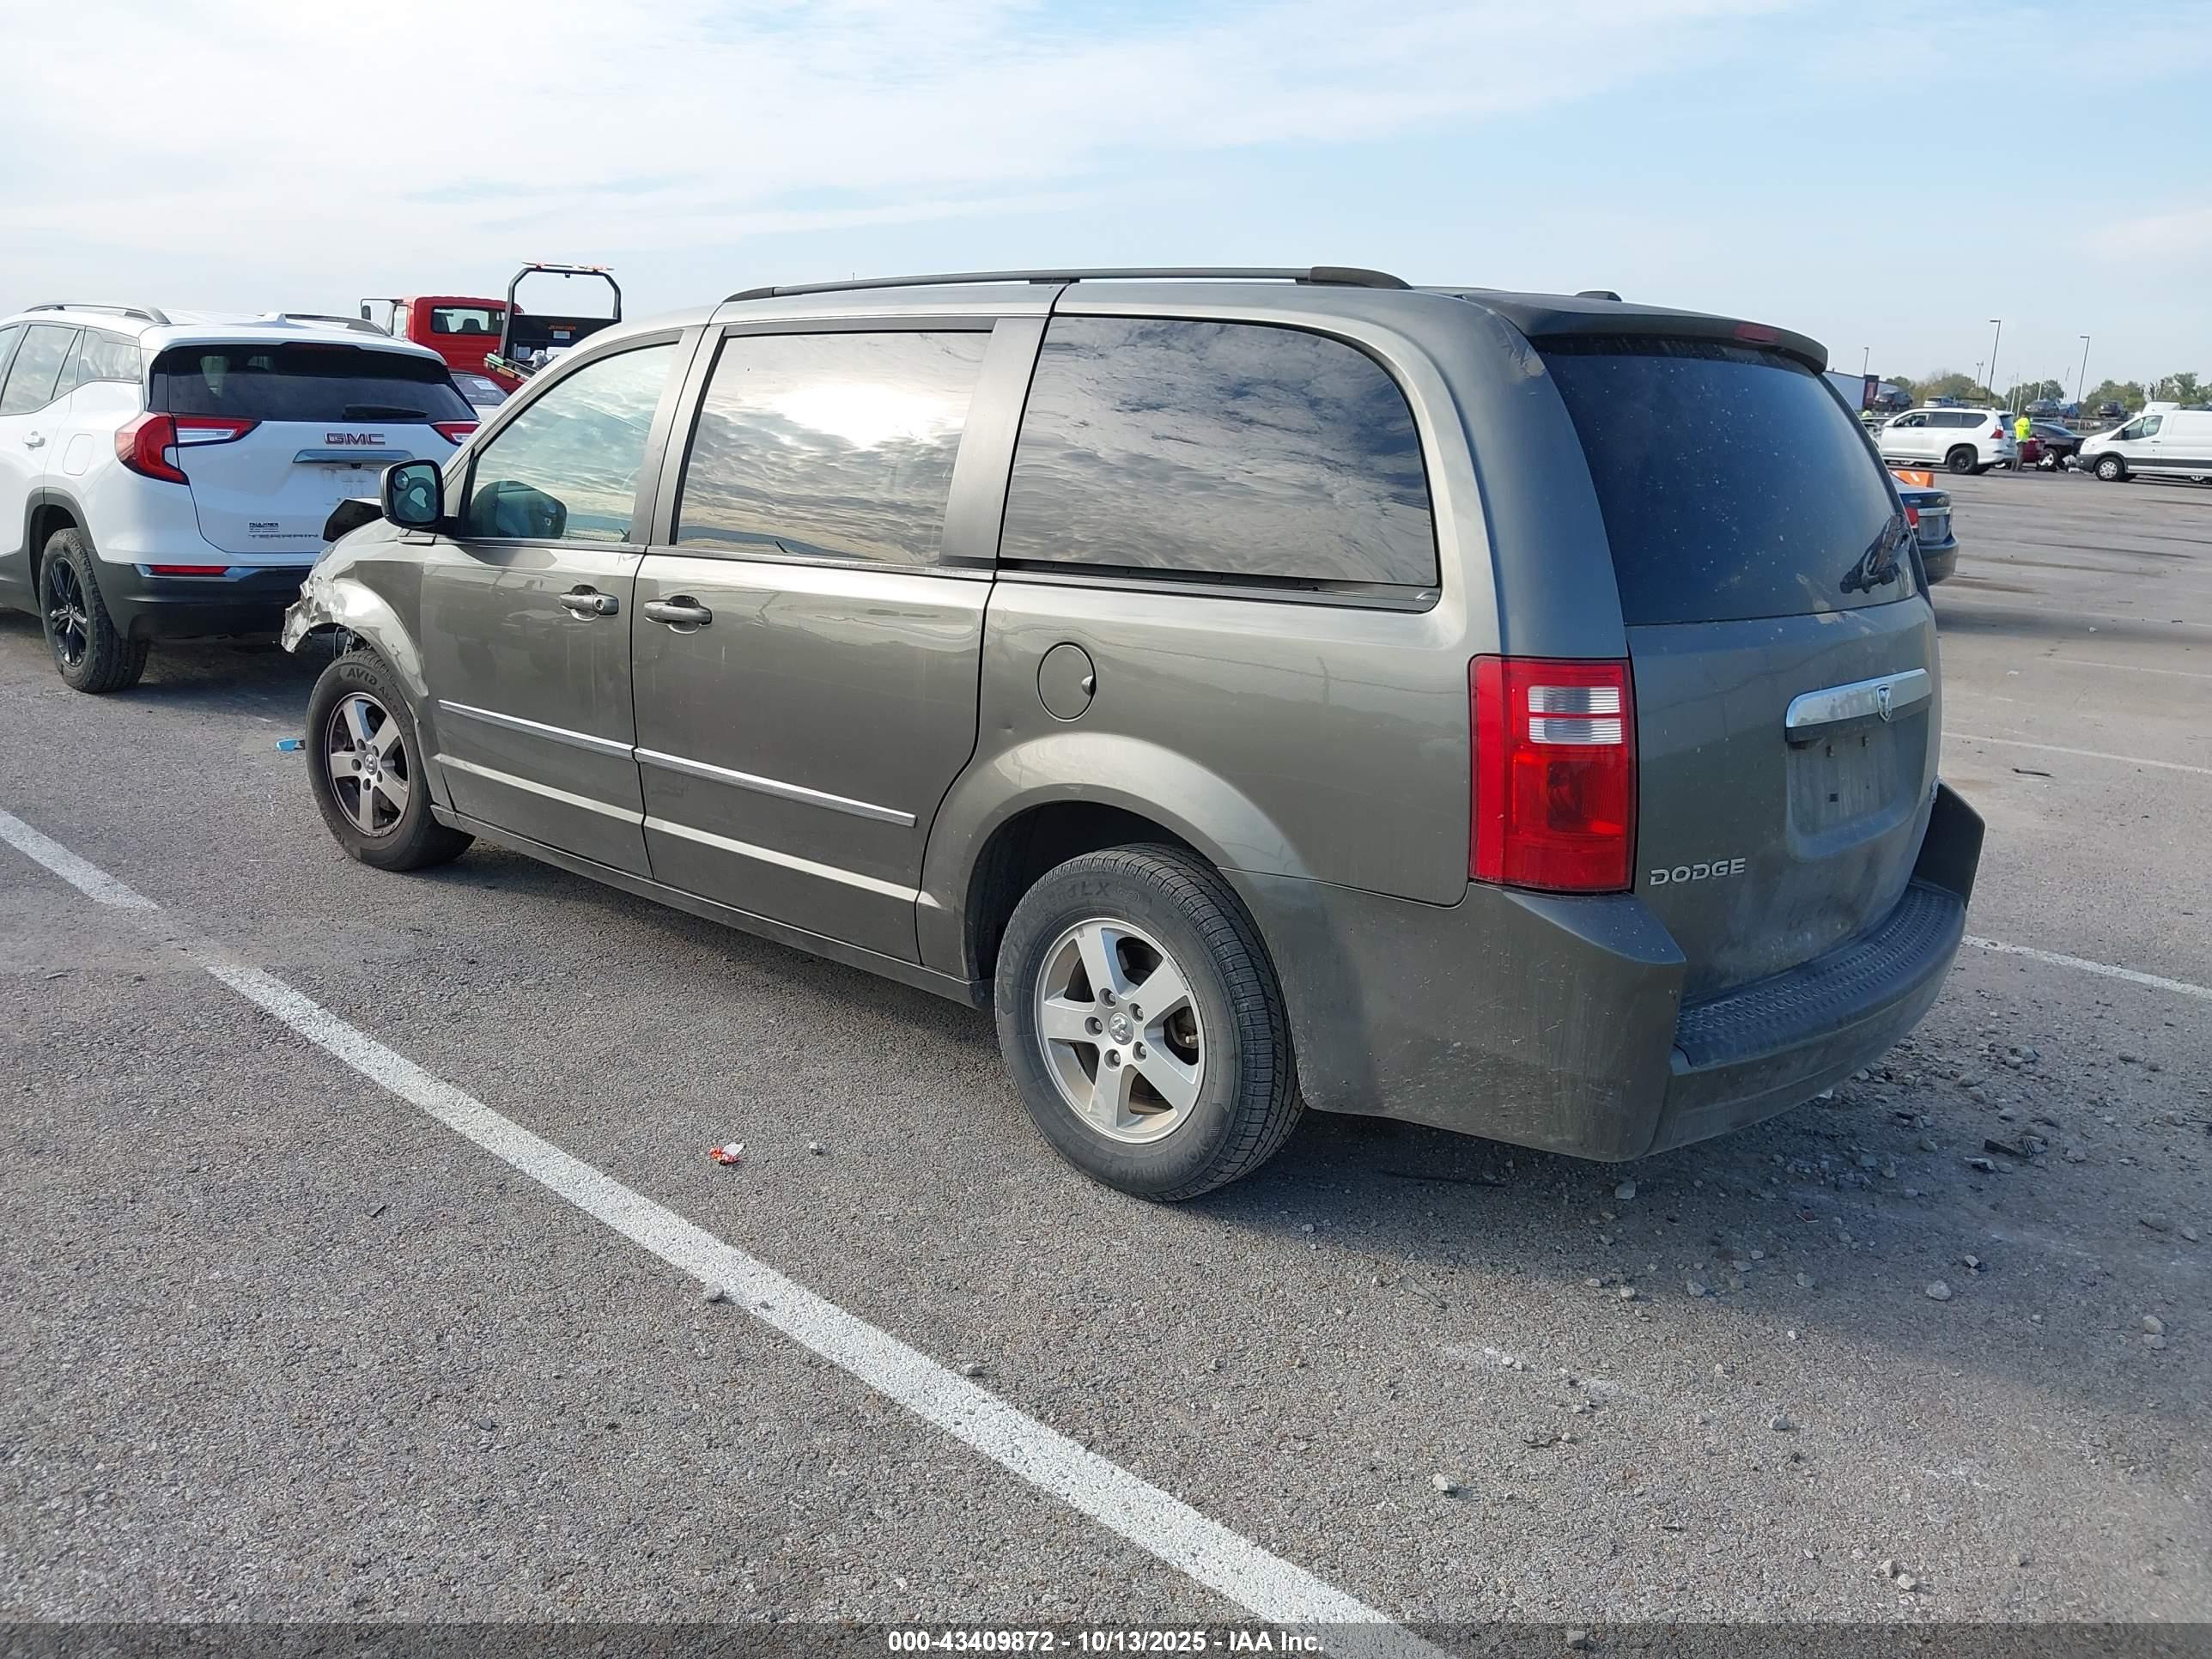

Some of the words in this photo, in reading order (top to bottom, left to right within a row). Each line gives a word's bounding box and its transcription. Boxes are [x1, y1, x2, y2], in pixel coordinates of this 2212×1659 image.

[325, 432, 386, 446] GMC
[347, 667, 378, 685] AVID
[1650, 857, 1746, 886] DODGE
